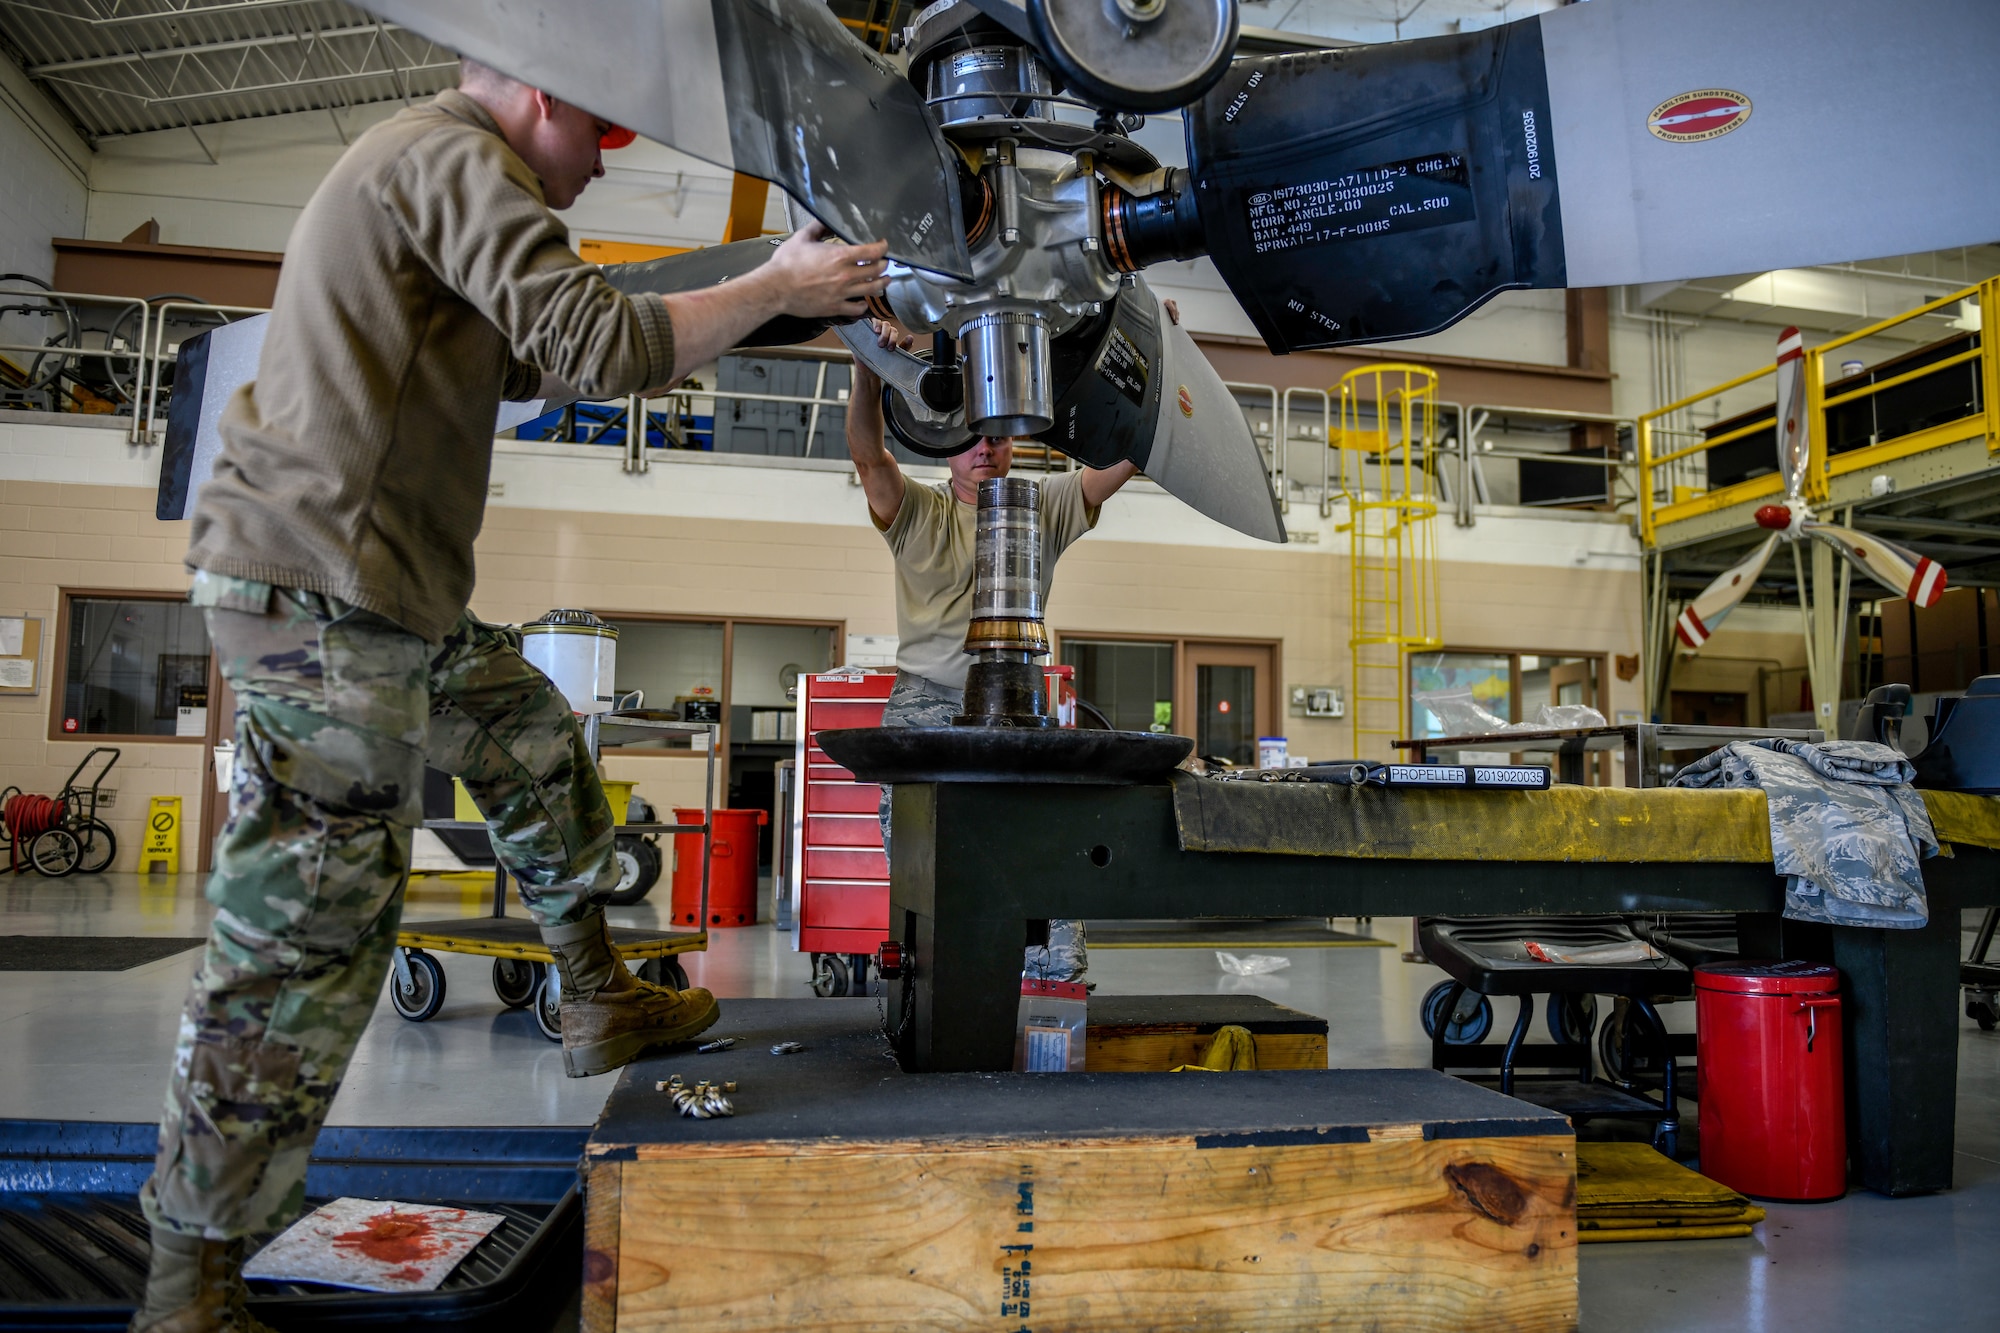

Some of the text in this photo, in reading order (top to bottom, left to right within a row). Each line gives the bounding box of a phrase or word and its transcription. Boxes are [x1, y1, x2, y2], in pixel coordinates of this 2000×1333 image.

[1225, 71, 1264, 122] NO STEP
[1653, 91, 1746, 118] HAMILTON SUNDSTRAND
[1522, 110, 1541, 179] 2019020035
[1657, 117, 1743, 141] PROPULSION SYSTEMS
[1200, 180, 1207, 190] 4
[911, 212, 934, 246] NO STEP
[1253, 196, 1450, 242] BAR.449 CAL.500
[1287, 299, 1341, 330] NO STEP
[1391, 768, 1543, 783] PROPELLER 2019020035
